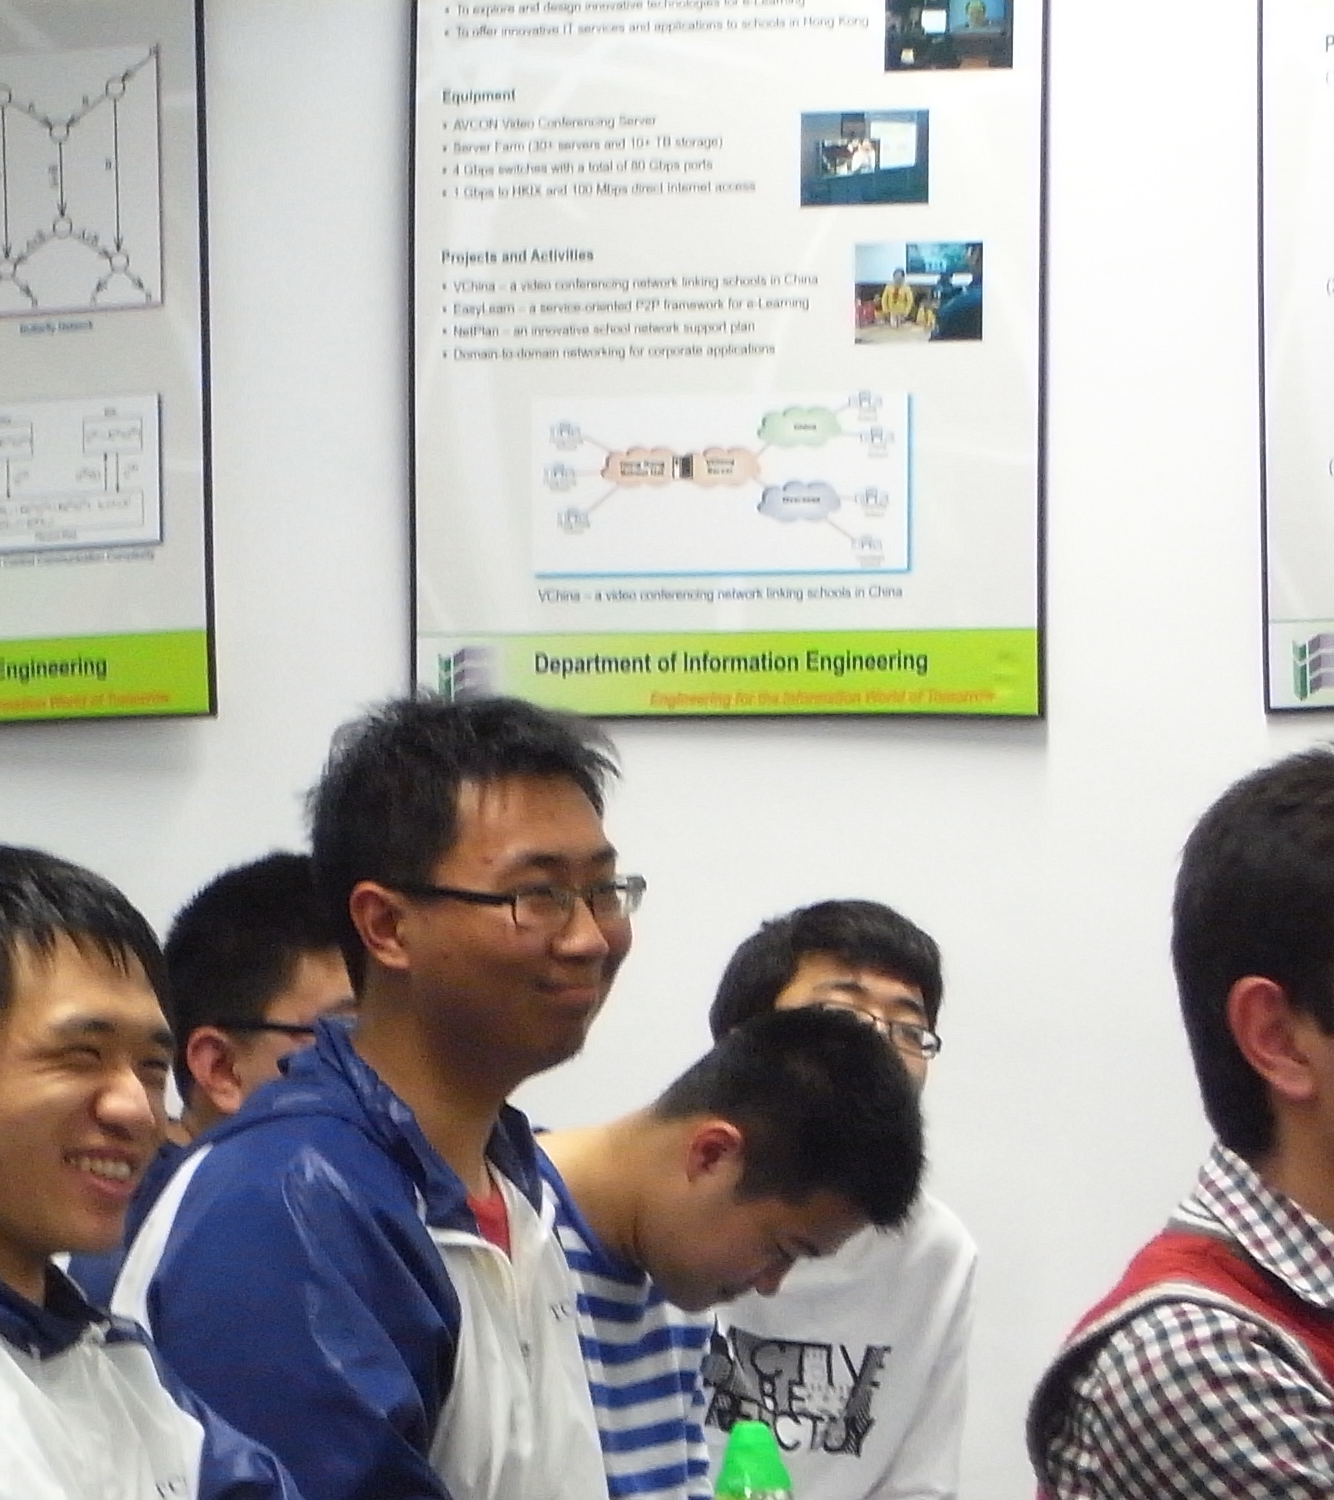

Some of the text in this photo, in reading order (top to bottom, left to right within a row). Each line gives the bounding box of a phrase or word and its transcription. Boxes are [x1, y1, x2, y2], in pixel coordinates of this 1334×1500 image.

[441, 90, 515, 105] Equipment
[440, 249, 594, 266] Projects and Activities
[534, 653, 928, 677] Department of Information Engineering
